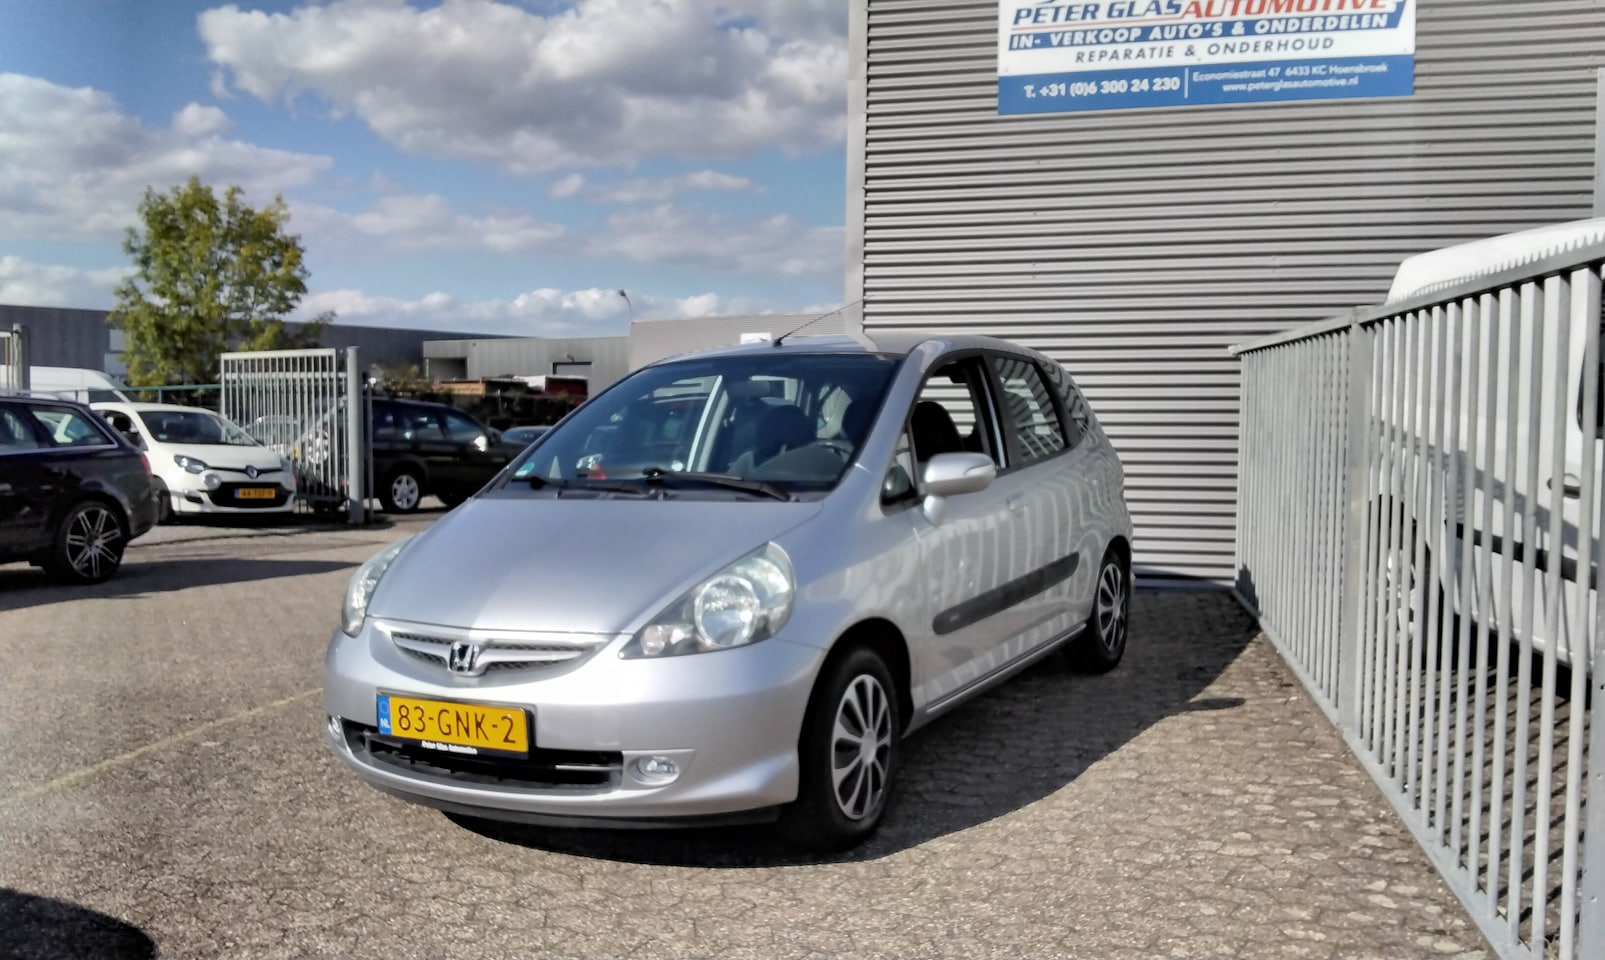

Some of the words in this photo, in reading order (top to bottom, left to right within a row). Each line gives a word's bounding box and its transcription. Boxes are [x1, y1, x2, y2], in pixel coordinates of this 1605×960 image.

[1012, 3, 1100, 26] PETER
[1106, 0, 1183, 19] GLAS
[1011, 34, 1042, 50] IN-
[1049, 27, 1142, 47] VERKOOP
[1149, 22, 1224, 41] AUTO'S
[1231, 20, 1246, 36] &
[1254, 13, 1388, 35] ONDERDELEN
[1075, 45, 1175, 64] REPARATIE
[1184, 44, 1196, 58] &
[1207, 36, 1334, 56] ONDERHOUD
[1193, 68, 1266, 82] Economiestraat
[1268, 66, 1281, 77] 47
[1285, 65, 1310, 77] 6433
[1312, 64, 1327, 75] KC
[1329, 61, 1389, 75] Hoensbroek
[1222, 76, 1359, 92] www.peterglasautomotive.nl
[1024, 84, 1037, 98] T.
[1039, 82, 1066, 97] +31
[1070, 81, 1098, 97] (0)6
[1100, 79, 1129, 94] 300
[1130, 78, 1150, 92] 24
[1152, 76, 1181, 91] 230
[398, 704, 517, 744] 83-GNK-2
